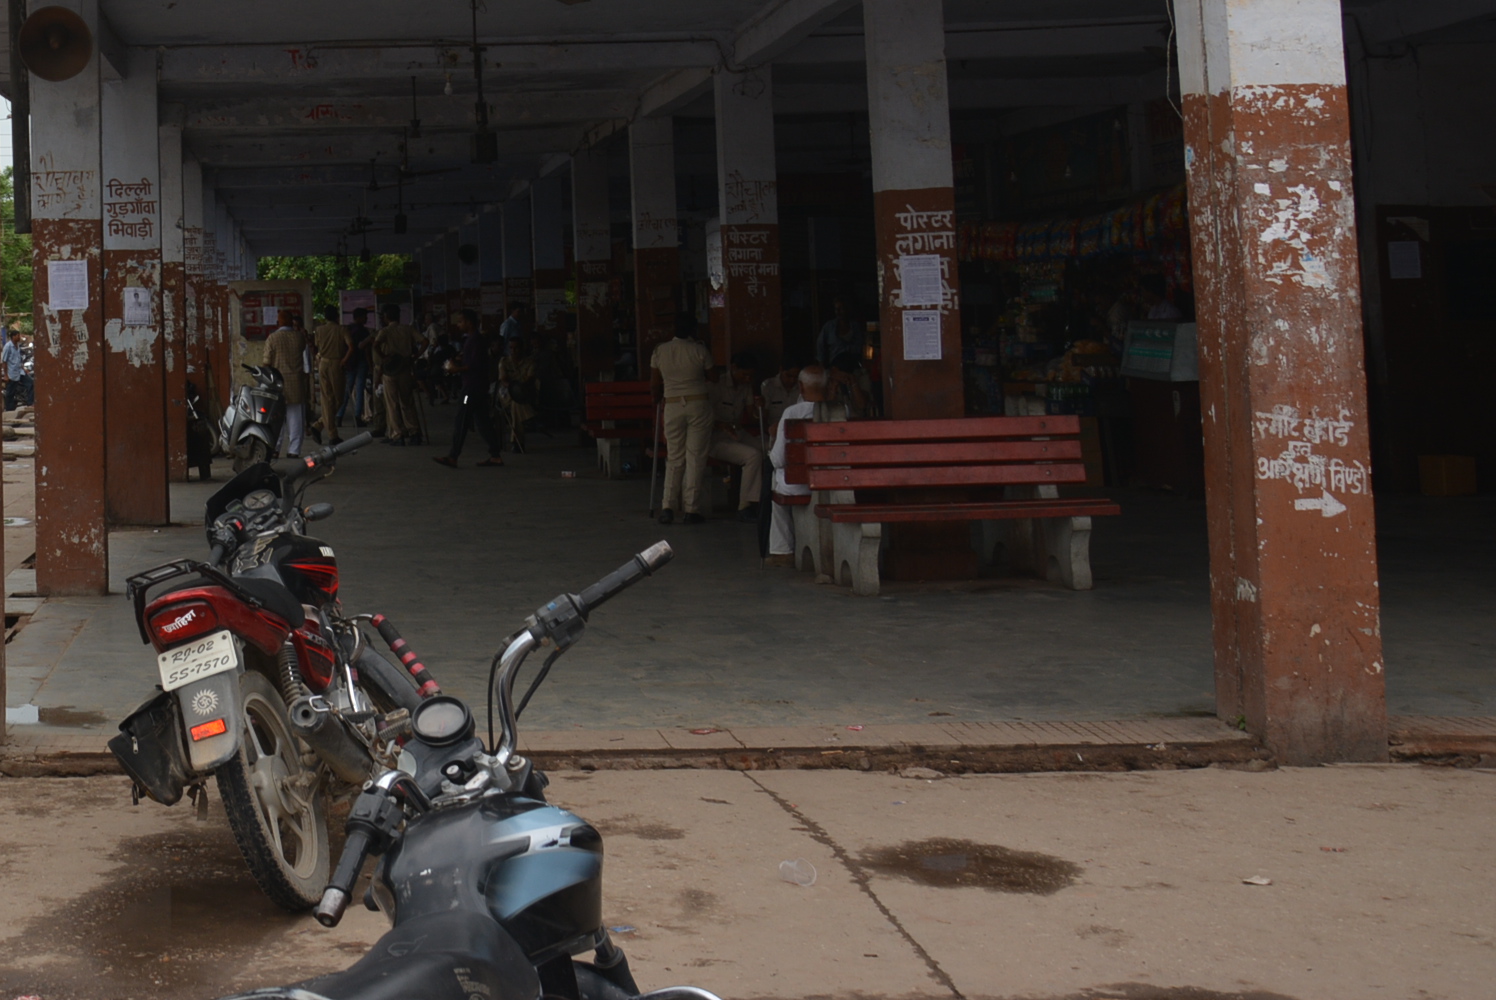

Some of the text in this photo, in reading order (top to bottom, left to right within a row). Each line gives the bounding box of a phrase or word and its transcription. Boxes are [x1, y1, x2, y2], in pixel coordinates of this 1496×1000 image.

[106, 177, 154, 198] दिल्ली
[895, 204, 953, 230] पोस्टर
[108, 219, 154, 241] भिवाड़ी
[728, 226, 769, 244] पोस्टर
[895, 230, 956, 255] लगाना
[729, 248, 763, 261] लगाना
[758, 263, 779, 276] मना
[172, 640, 214, 664] RJ-02
[168, 655, 230, 685] SS-7570
